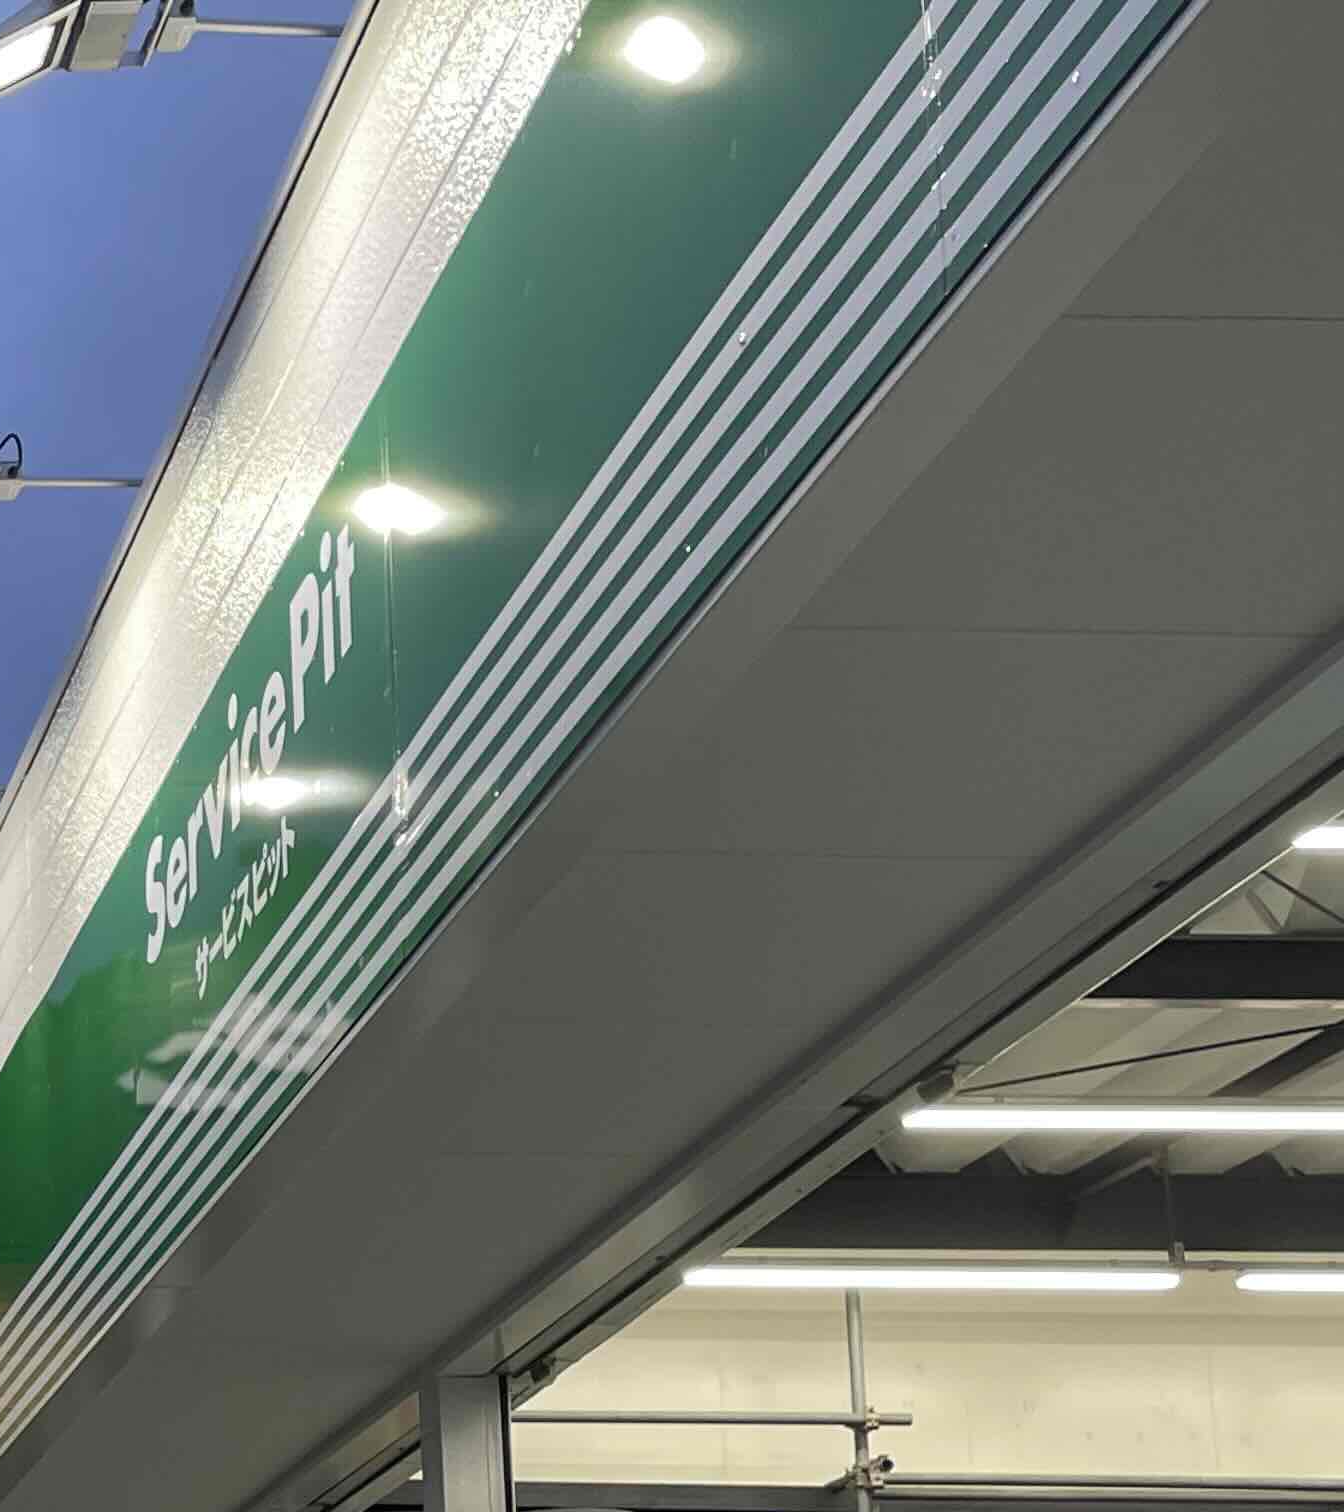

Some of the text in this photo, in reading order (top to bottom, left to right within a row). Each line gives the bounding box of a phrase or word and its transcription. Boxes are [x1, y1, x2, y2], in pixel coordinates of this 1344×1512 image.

[144, 523, 356, 965] Service Pit
[195, 816, 296, 1001] サービスピット
